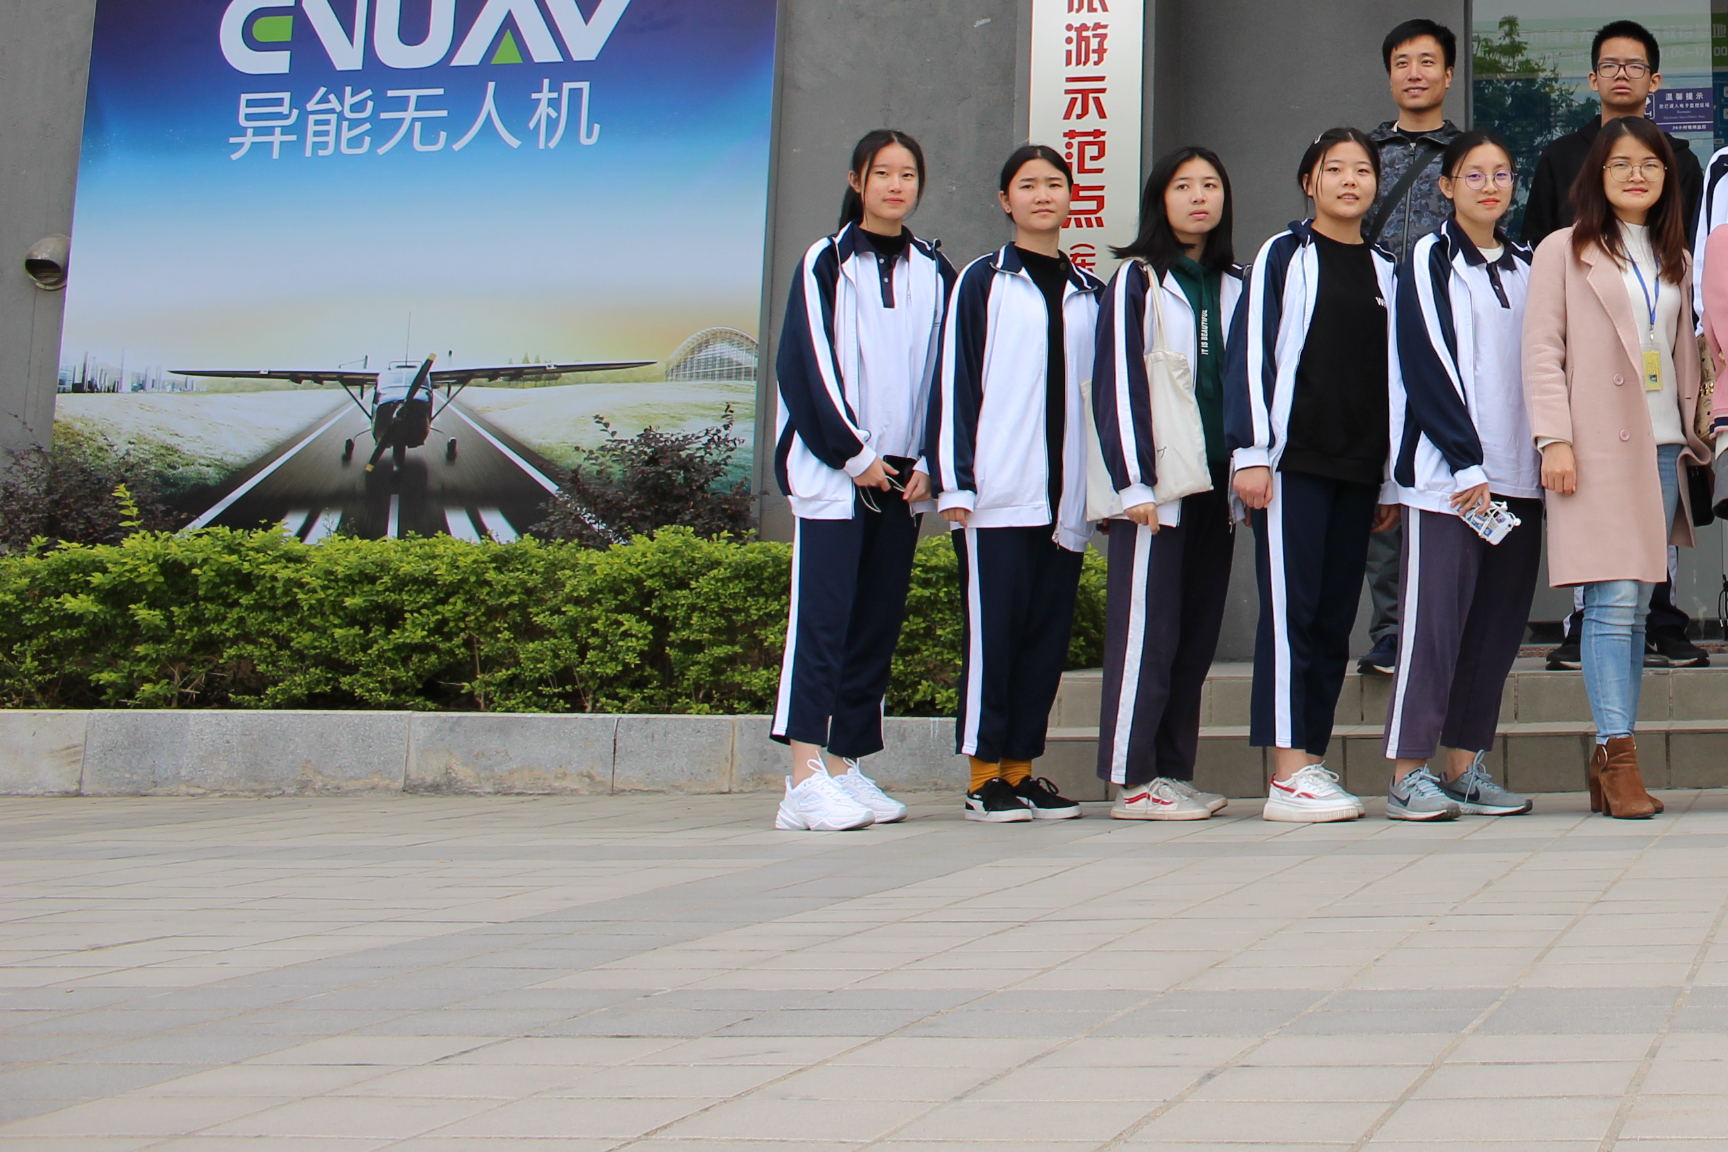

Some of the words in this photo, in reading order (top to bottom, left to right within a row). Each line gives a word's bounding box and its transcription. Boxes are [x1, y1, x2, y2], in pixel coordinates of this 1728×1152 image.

[228, 77, 601, 161] 异能无人机
[1201, 309, 1209, 341] BEAUTIFUL
